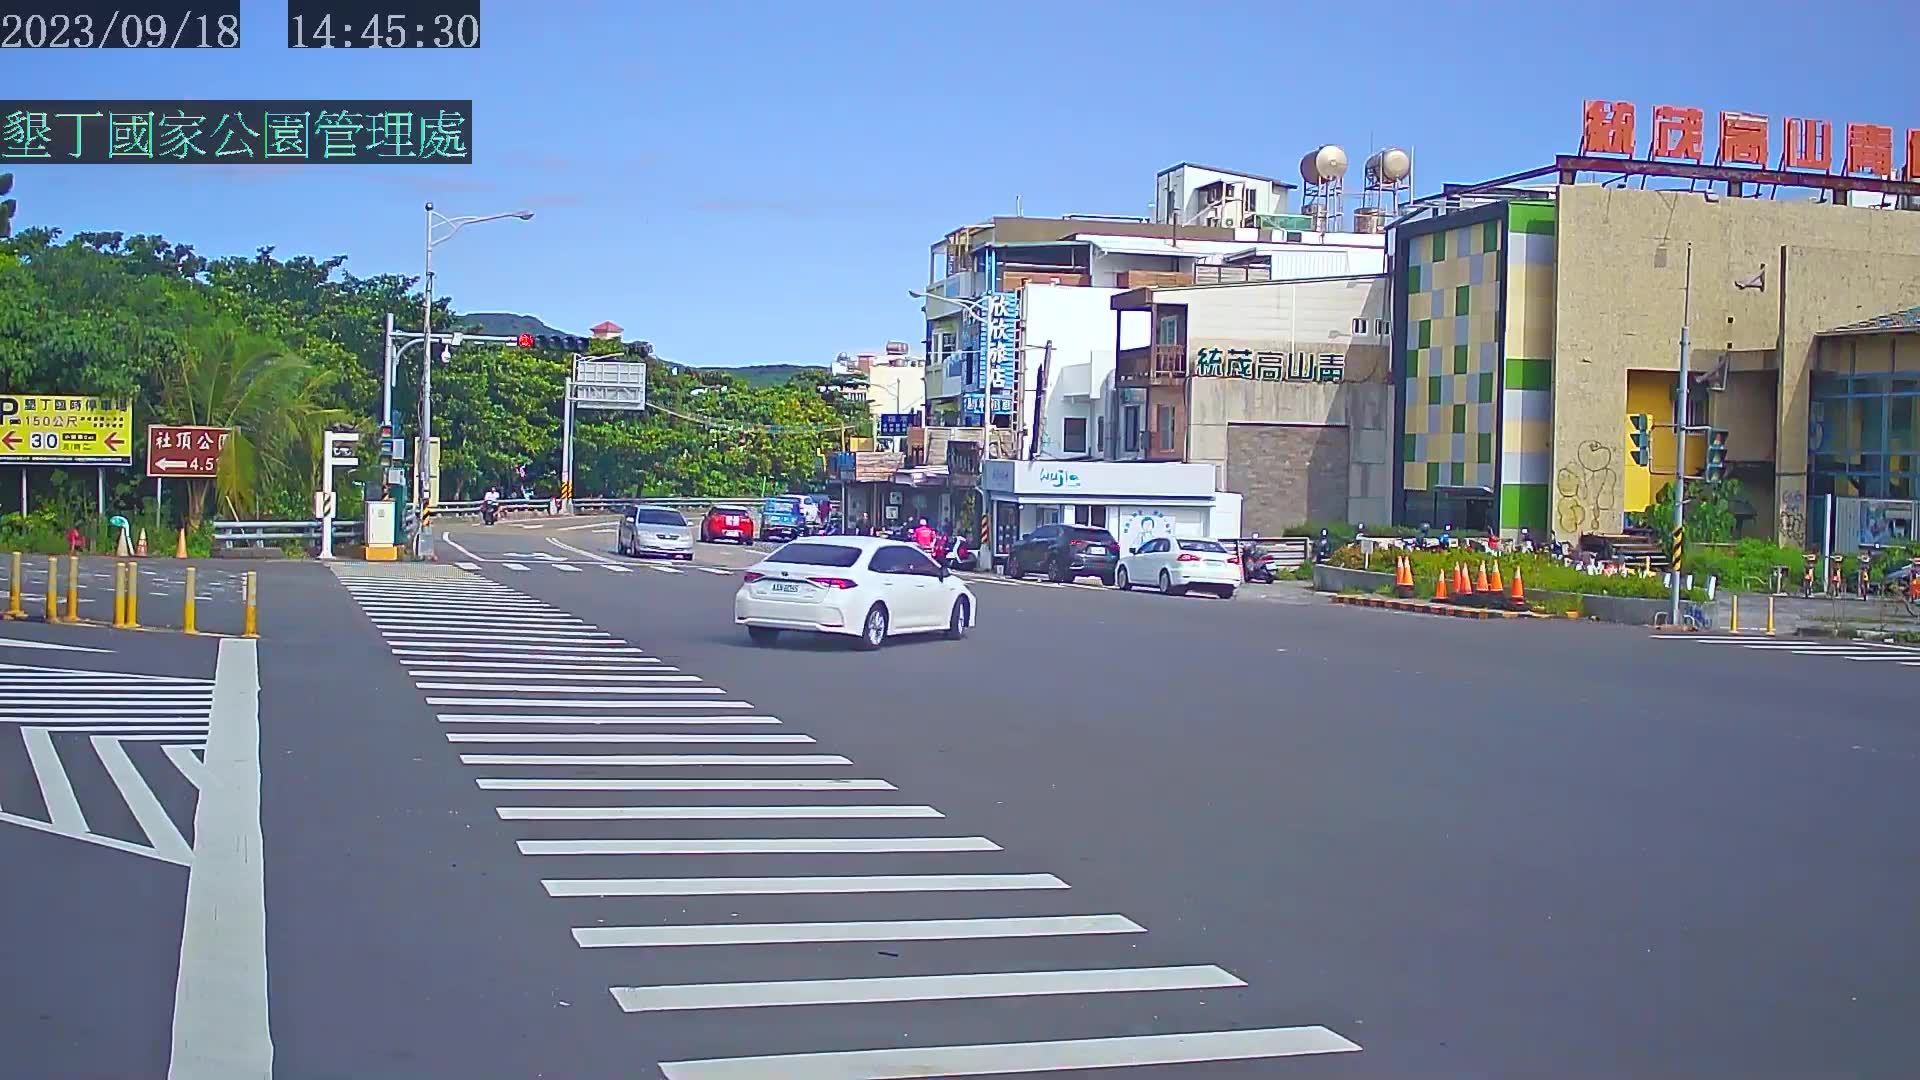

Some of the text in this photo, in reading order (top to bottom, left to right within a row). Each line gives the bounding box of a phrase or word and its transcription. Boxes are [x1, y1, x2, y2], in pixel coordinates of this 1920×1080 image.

[1196, 347, 1344, 382] 統茂高山青
[26, 416, 78, 428] 150公尺
[31, 433, 58, 449] 30
